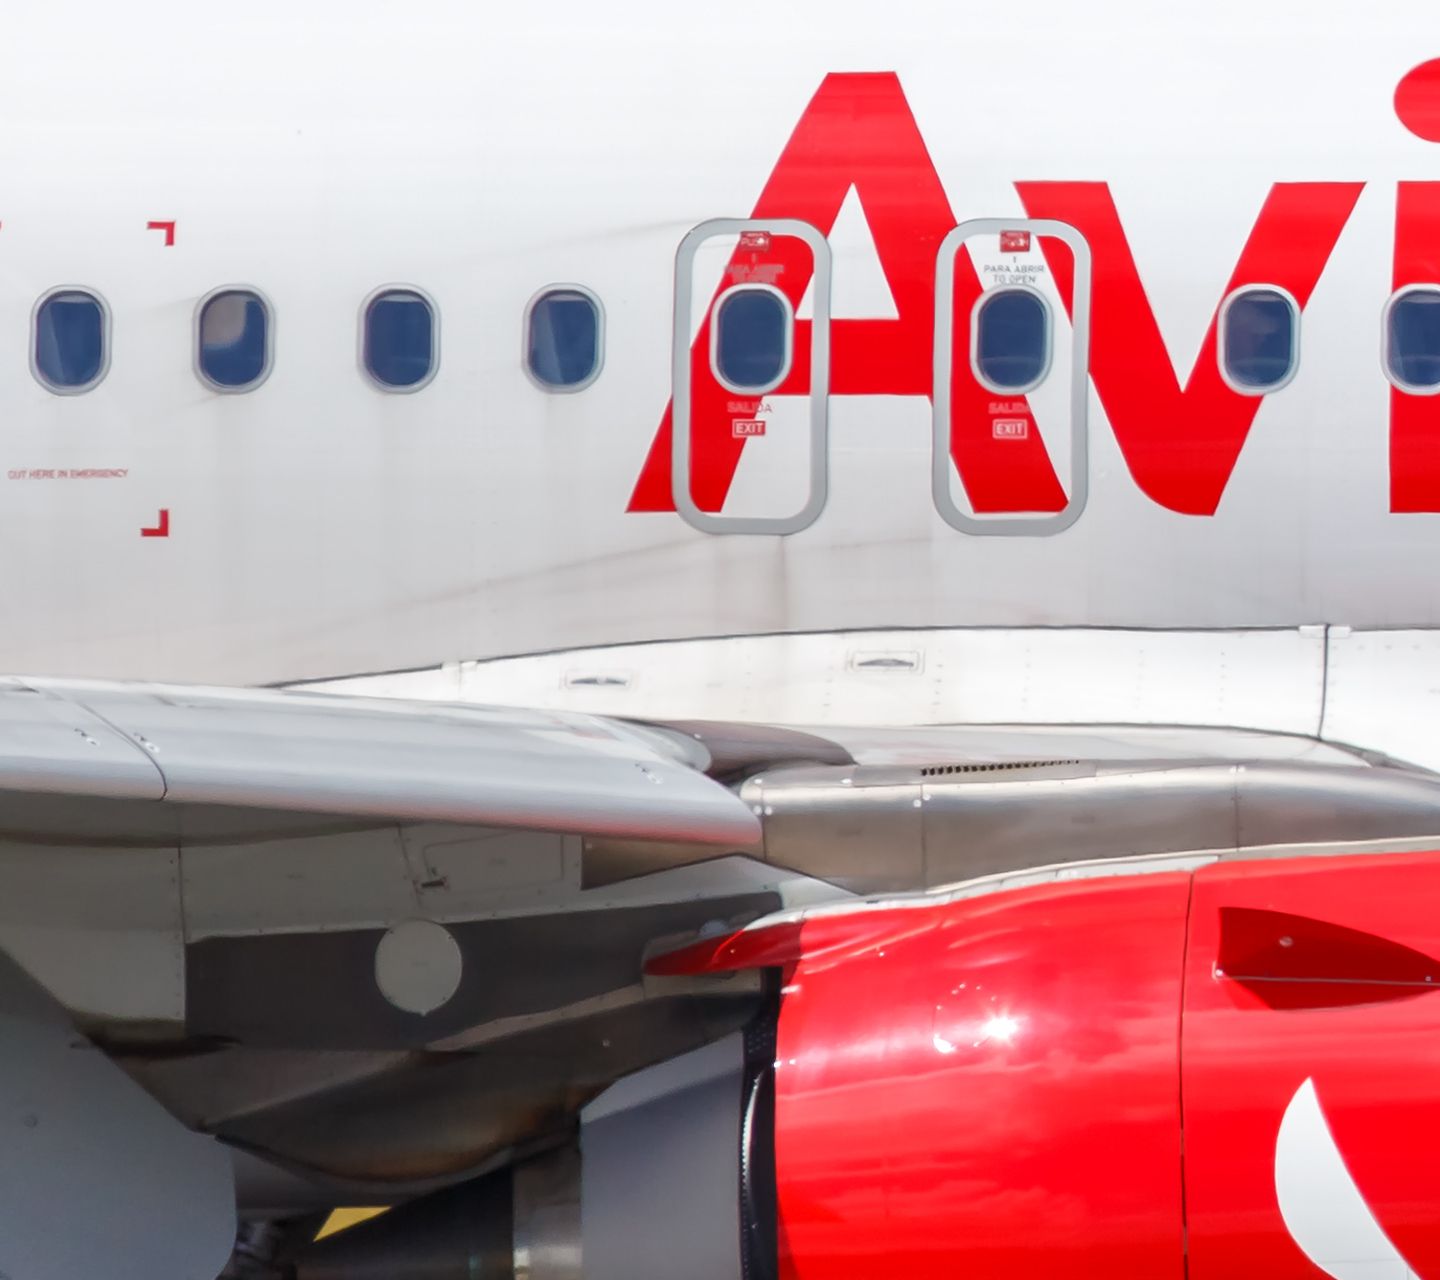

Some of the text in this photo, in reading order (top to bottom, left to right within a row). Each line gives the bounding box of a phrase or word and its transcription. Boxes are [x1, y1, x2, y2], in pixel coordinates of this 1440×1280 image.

[983, 265, 1045, 273] PARA ABRIR
[1009, 274, 1036, 284] OPEN
[726, 400, 773, 414] SALIDA
[735, 422, 764, 434] EXIT
[995, 422, 1024, 435] EXIT
